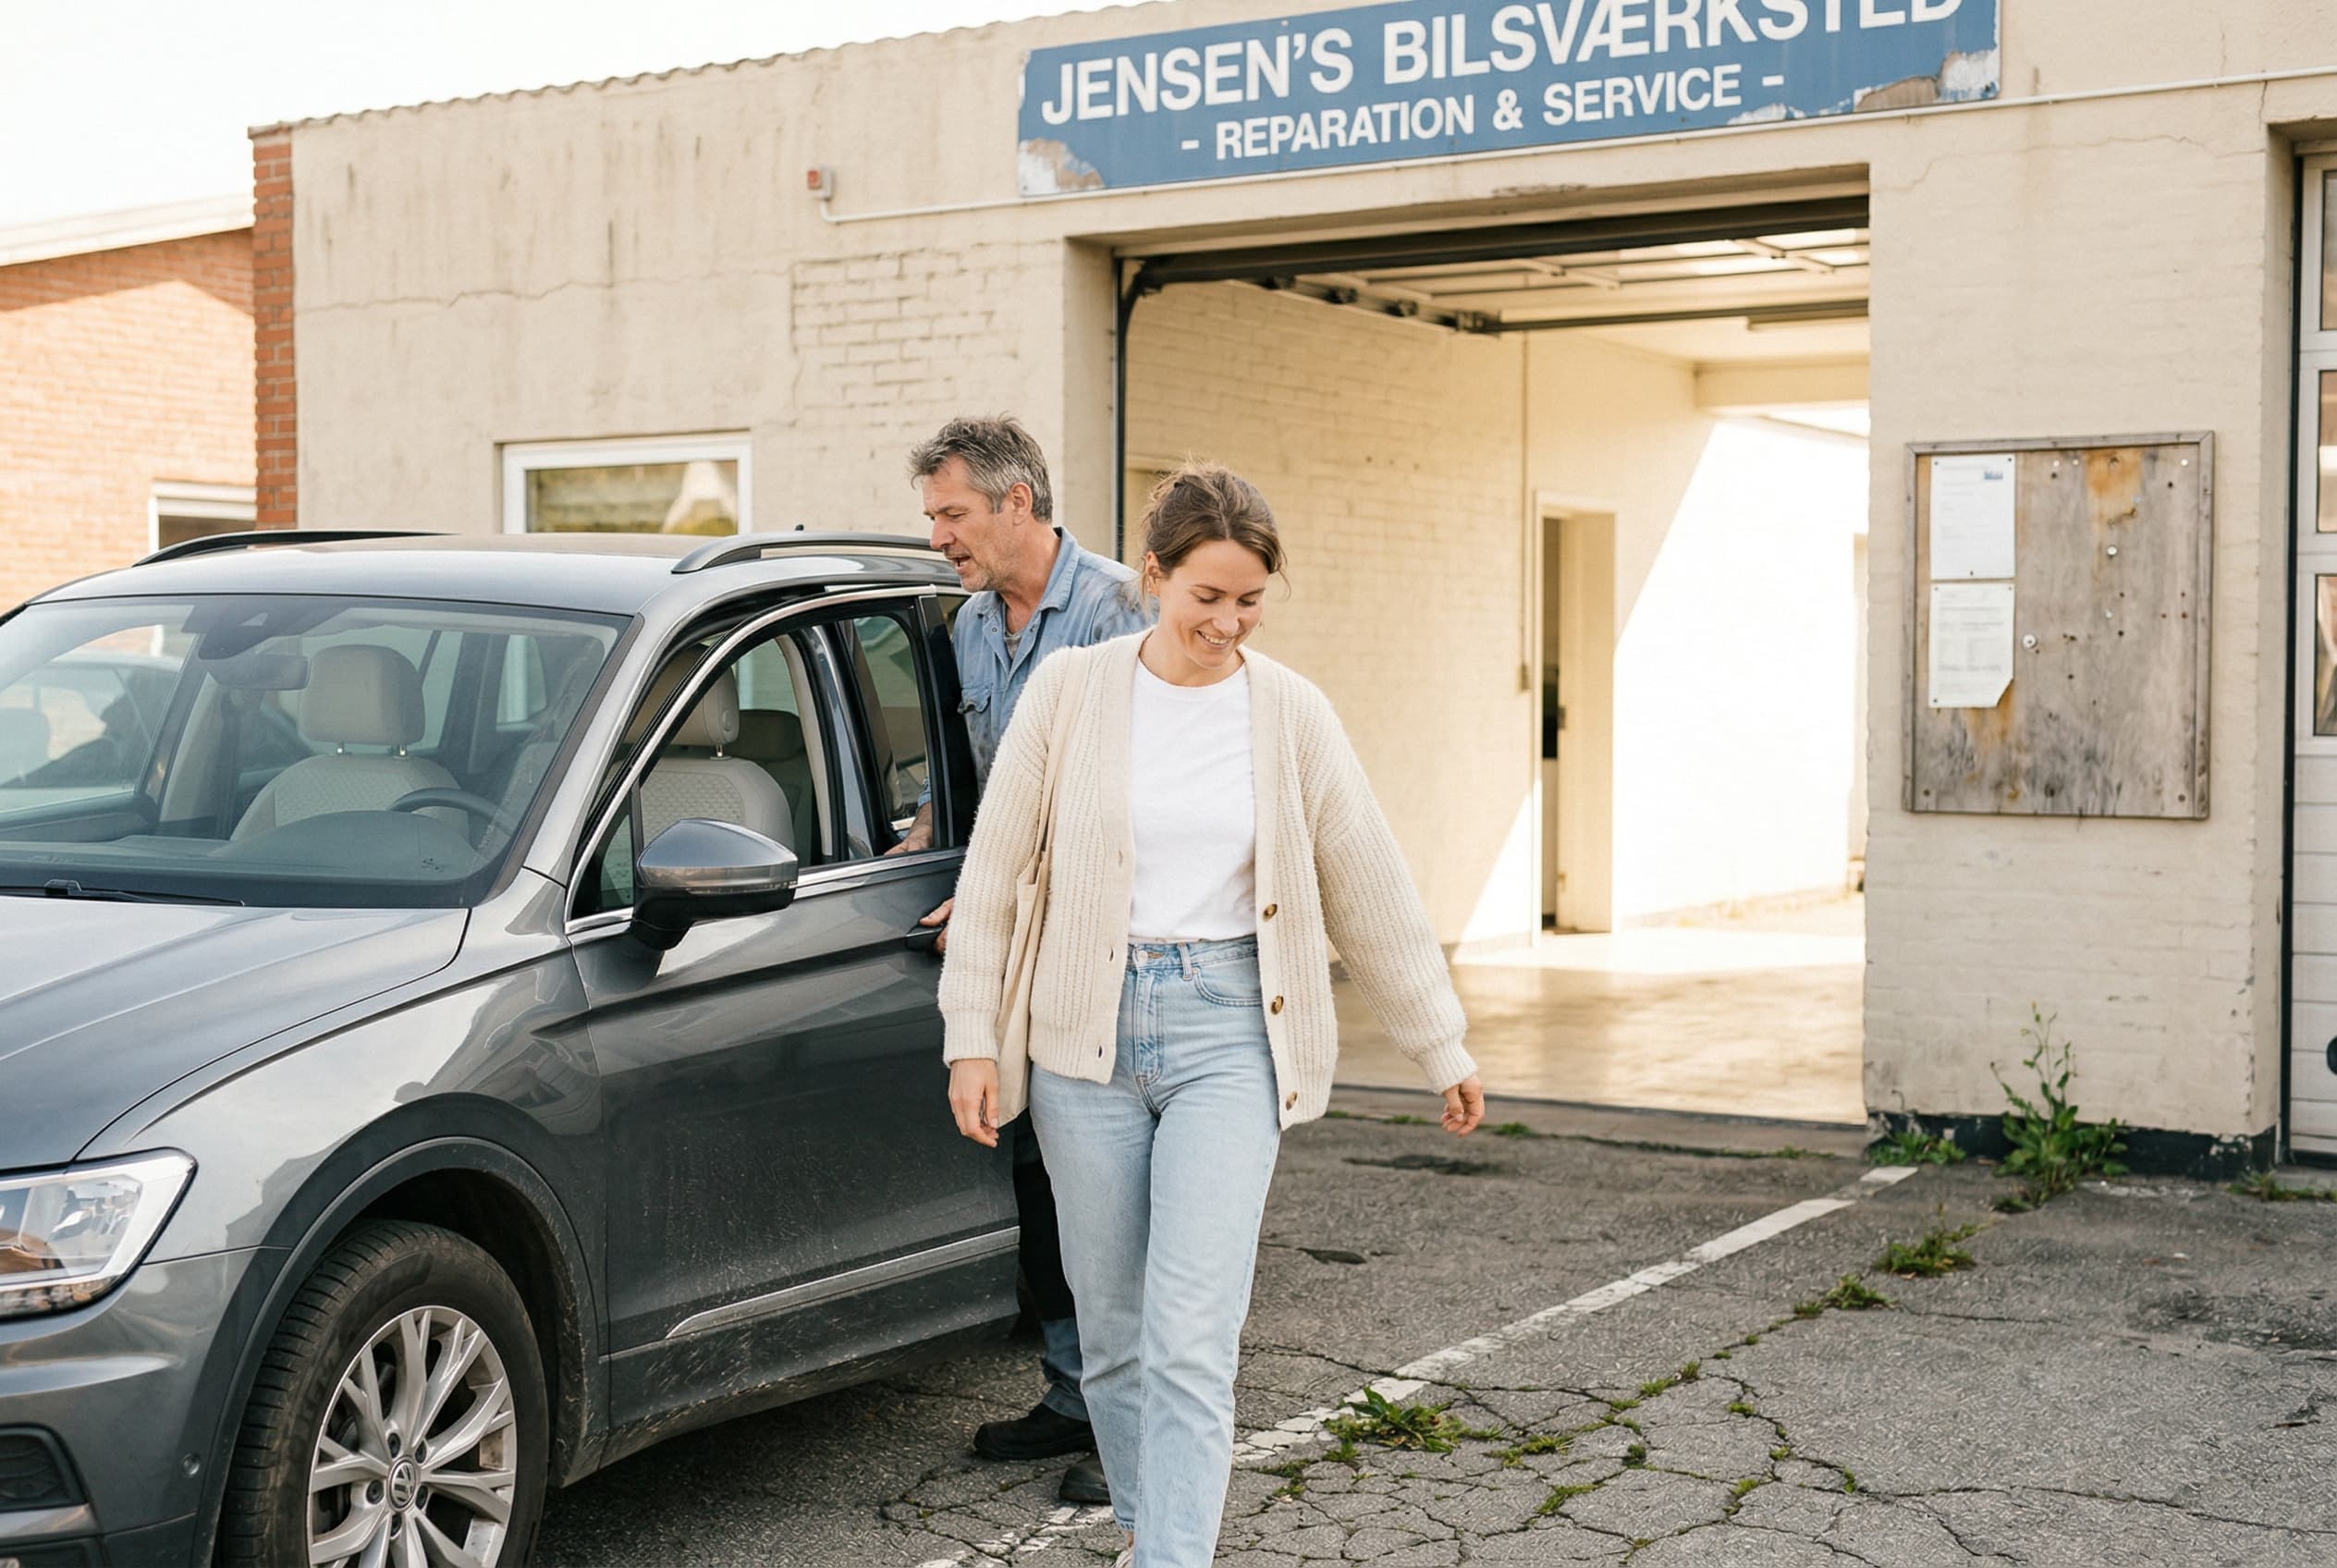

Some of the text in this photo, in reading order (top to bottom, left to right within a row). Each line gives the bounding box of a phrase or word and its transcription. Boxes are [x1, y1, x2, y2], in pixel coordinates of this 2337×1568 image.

[1041, 28, 1354, 125] JENSEN'S
[1216, 94, 1474, 160] REPARATION
[1492, 89, 1523, 131] &
[1543, 67, 1743, 126] SERVICE
